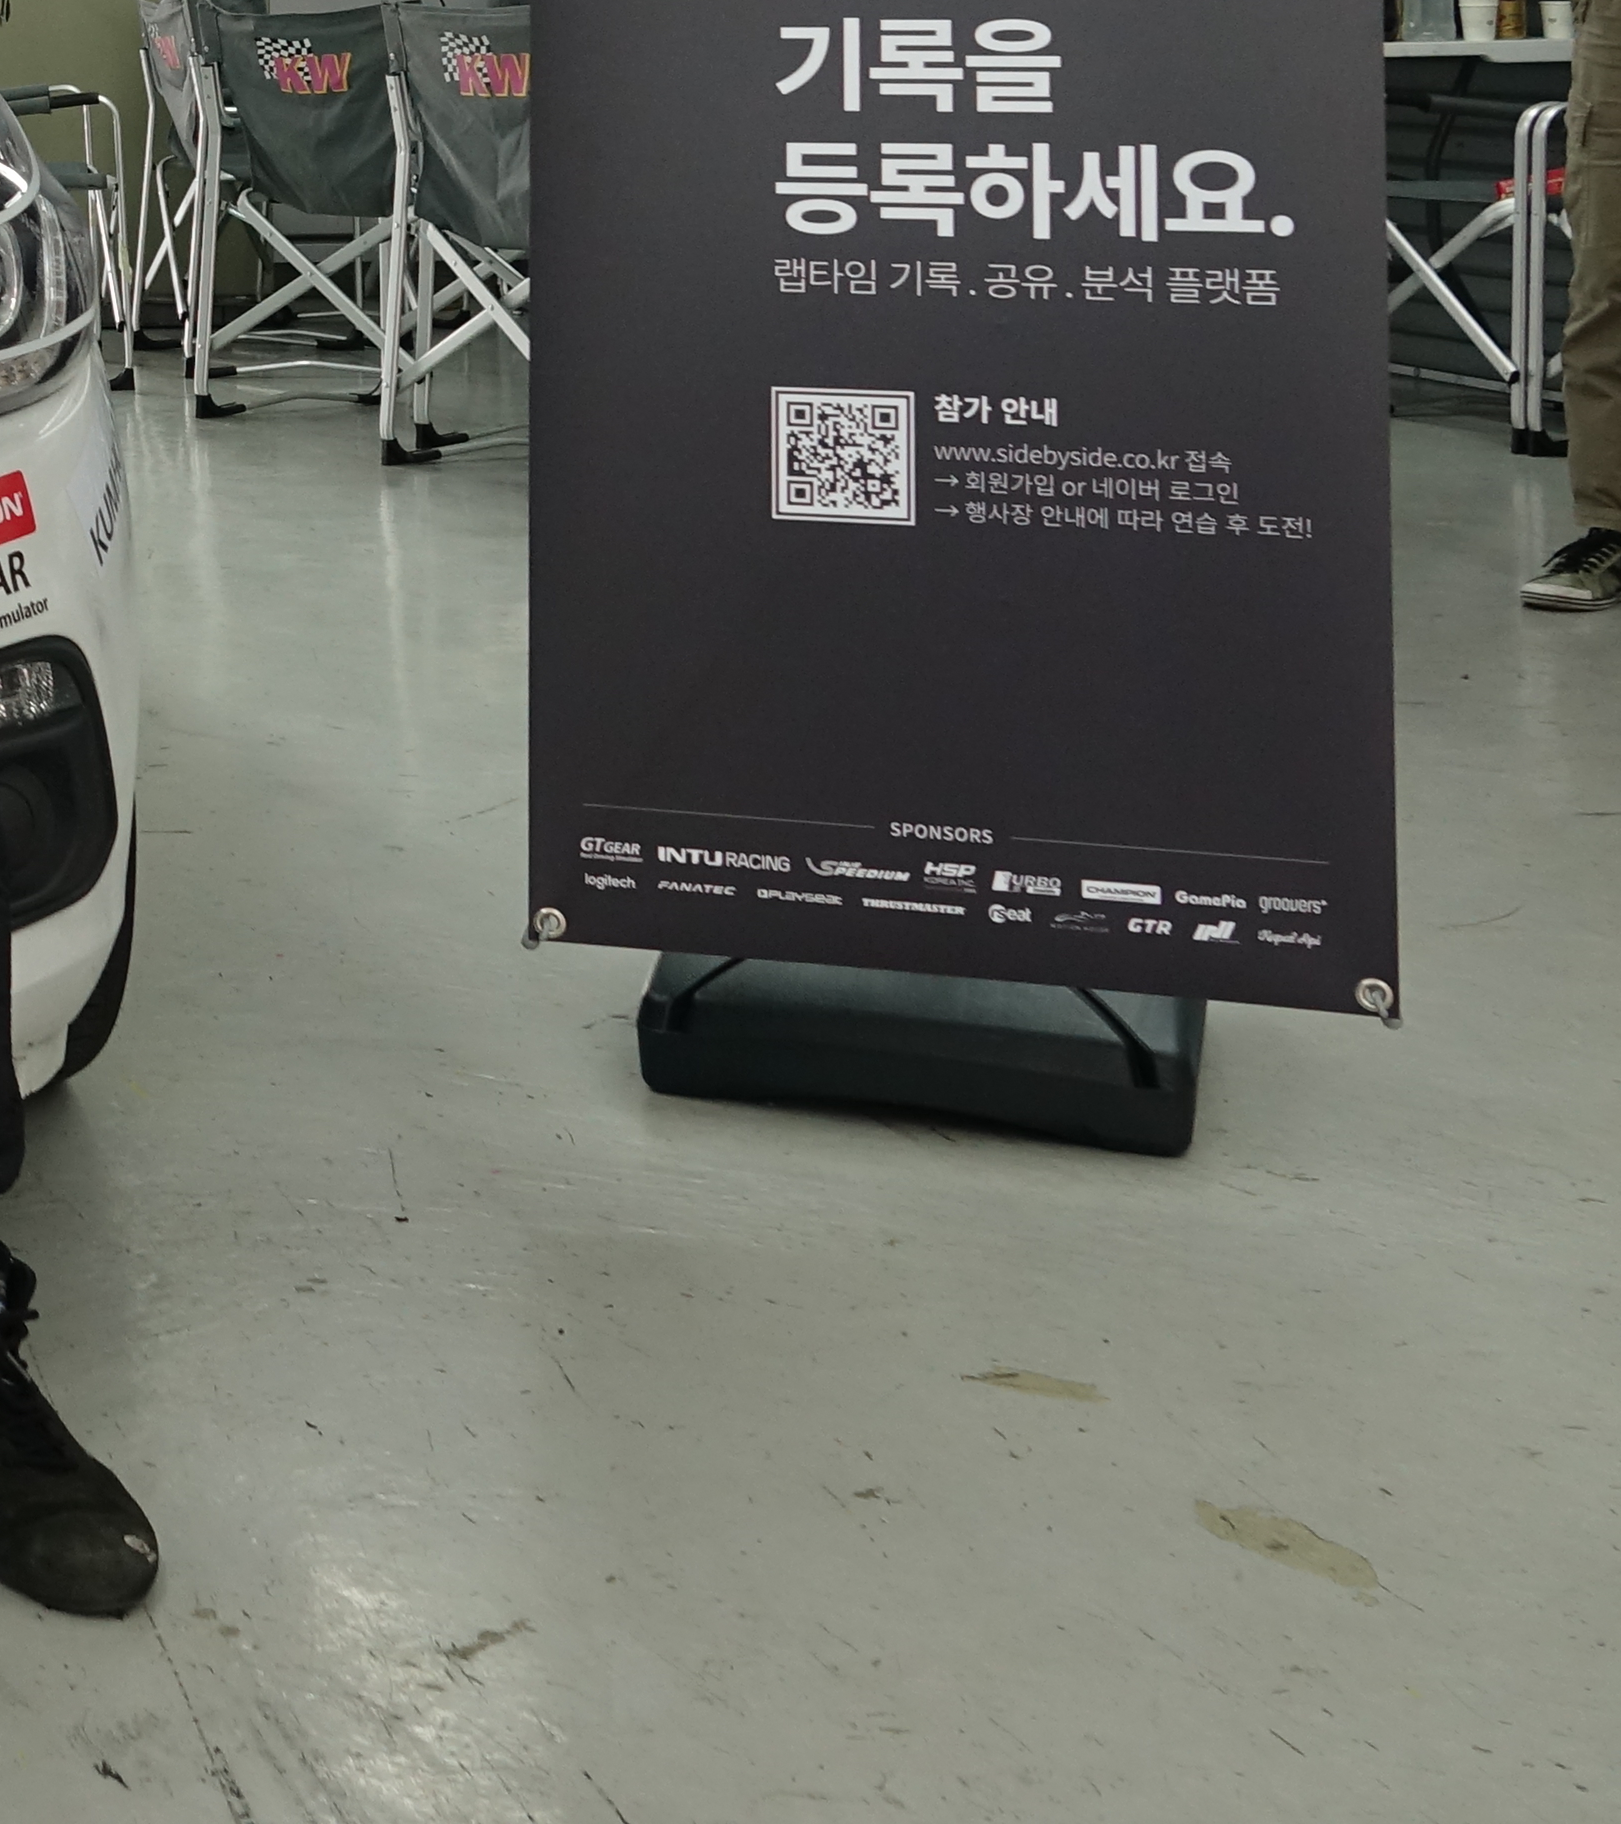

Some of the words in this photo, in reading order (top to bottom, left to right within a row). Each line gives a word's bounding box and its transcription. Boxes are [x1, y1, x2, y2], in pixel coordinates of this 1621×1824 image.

[274, 51, 352, 95] KW
[456, 51, 531, 98] KW
[775, 17, 1062, 113] 기록을
[775, 142, 1295, 242] 등록하세요.
[773, 257, 877, 296] 랩타임
[1080, 266, 1154, 302] 분석
[1165, 268, 1281, 306] 플랫폼
[933, 393, 993, 425] 참가
[1000, 396, 1058, 427] 안내
[933, 443, 1180, 471] www.sidebyside.co.kr
[1184, 449, 1233, 474] 접속
[964, 470, 1056, 497] 회원가입
[1061, 480, 1087, 497] or
[1092, 477, 1160, 502] 네이버
[1168, 480, 1240, 505] 로그인
[964, 501, 1034, 526] 행사장
[1041, 505, 1109, 529] 안내에
[1117, 508, 1165, 533] 따라
[1171, 510, 1218, 535] 연습
[1225, 513, 1251, 536] 후
[1257, 515, 1313, 539] 도전!
[890, 821, 994, 845] SPONSORS
[657, 845, 723, 867] INTU
[725, 850, 791, 873] RACING
[924, 861, 977, 877] HSP
[584, 872, 637, 891] logitech
[657, 880, 738, 897] FANATEC
[861, 897, 967, 916] THRUSTMASTER
[1175, 890, 1247, 910] GamePia
[1127, 917, 1173, 936] GTR
